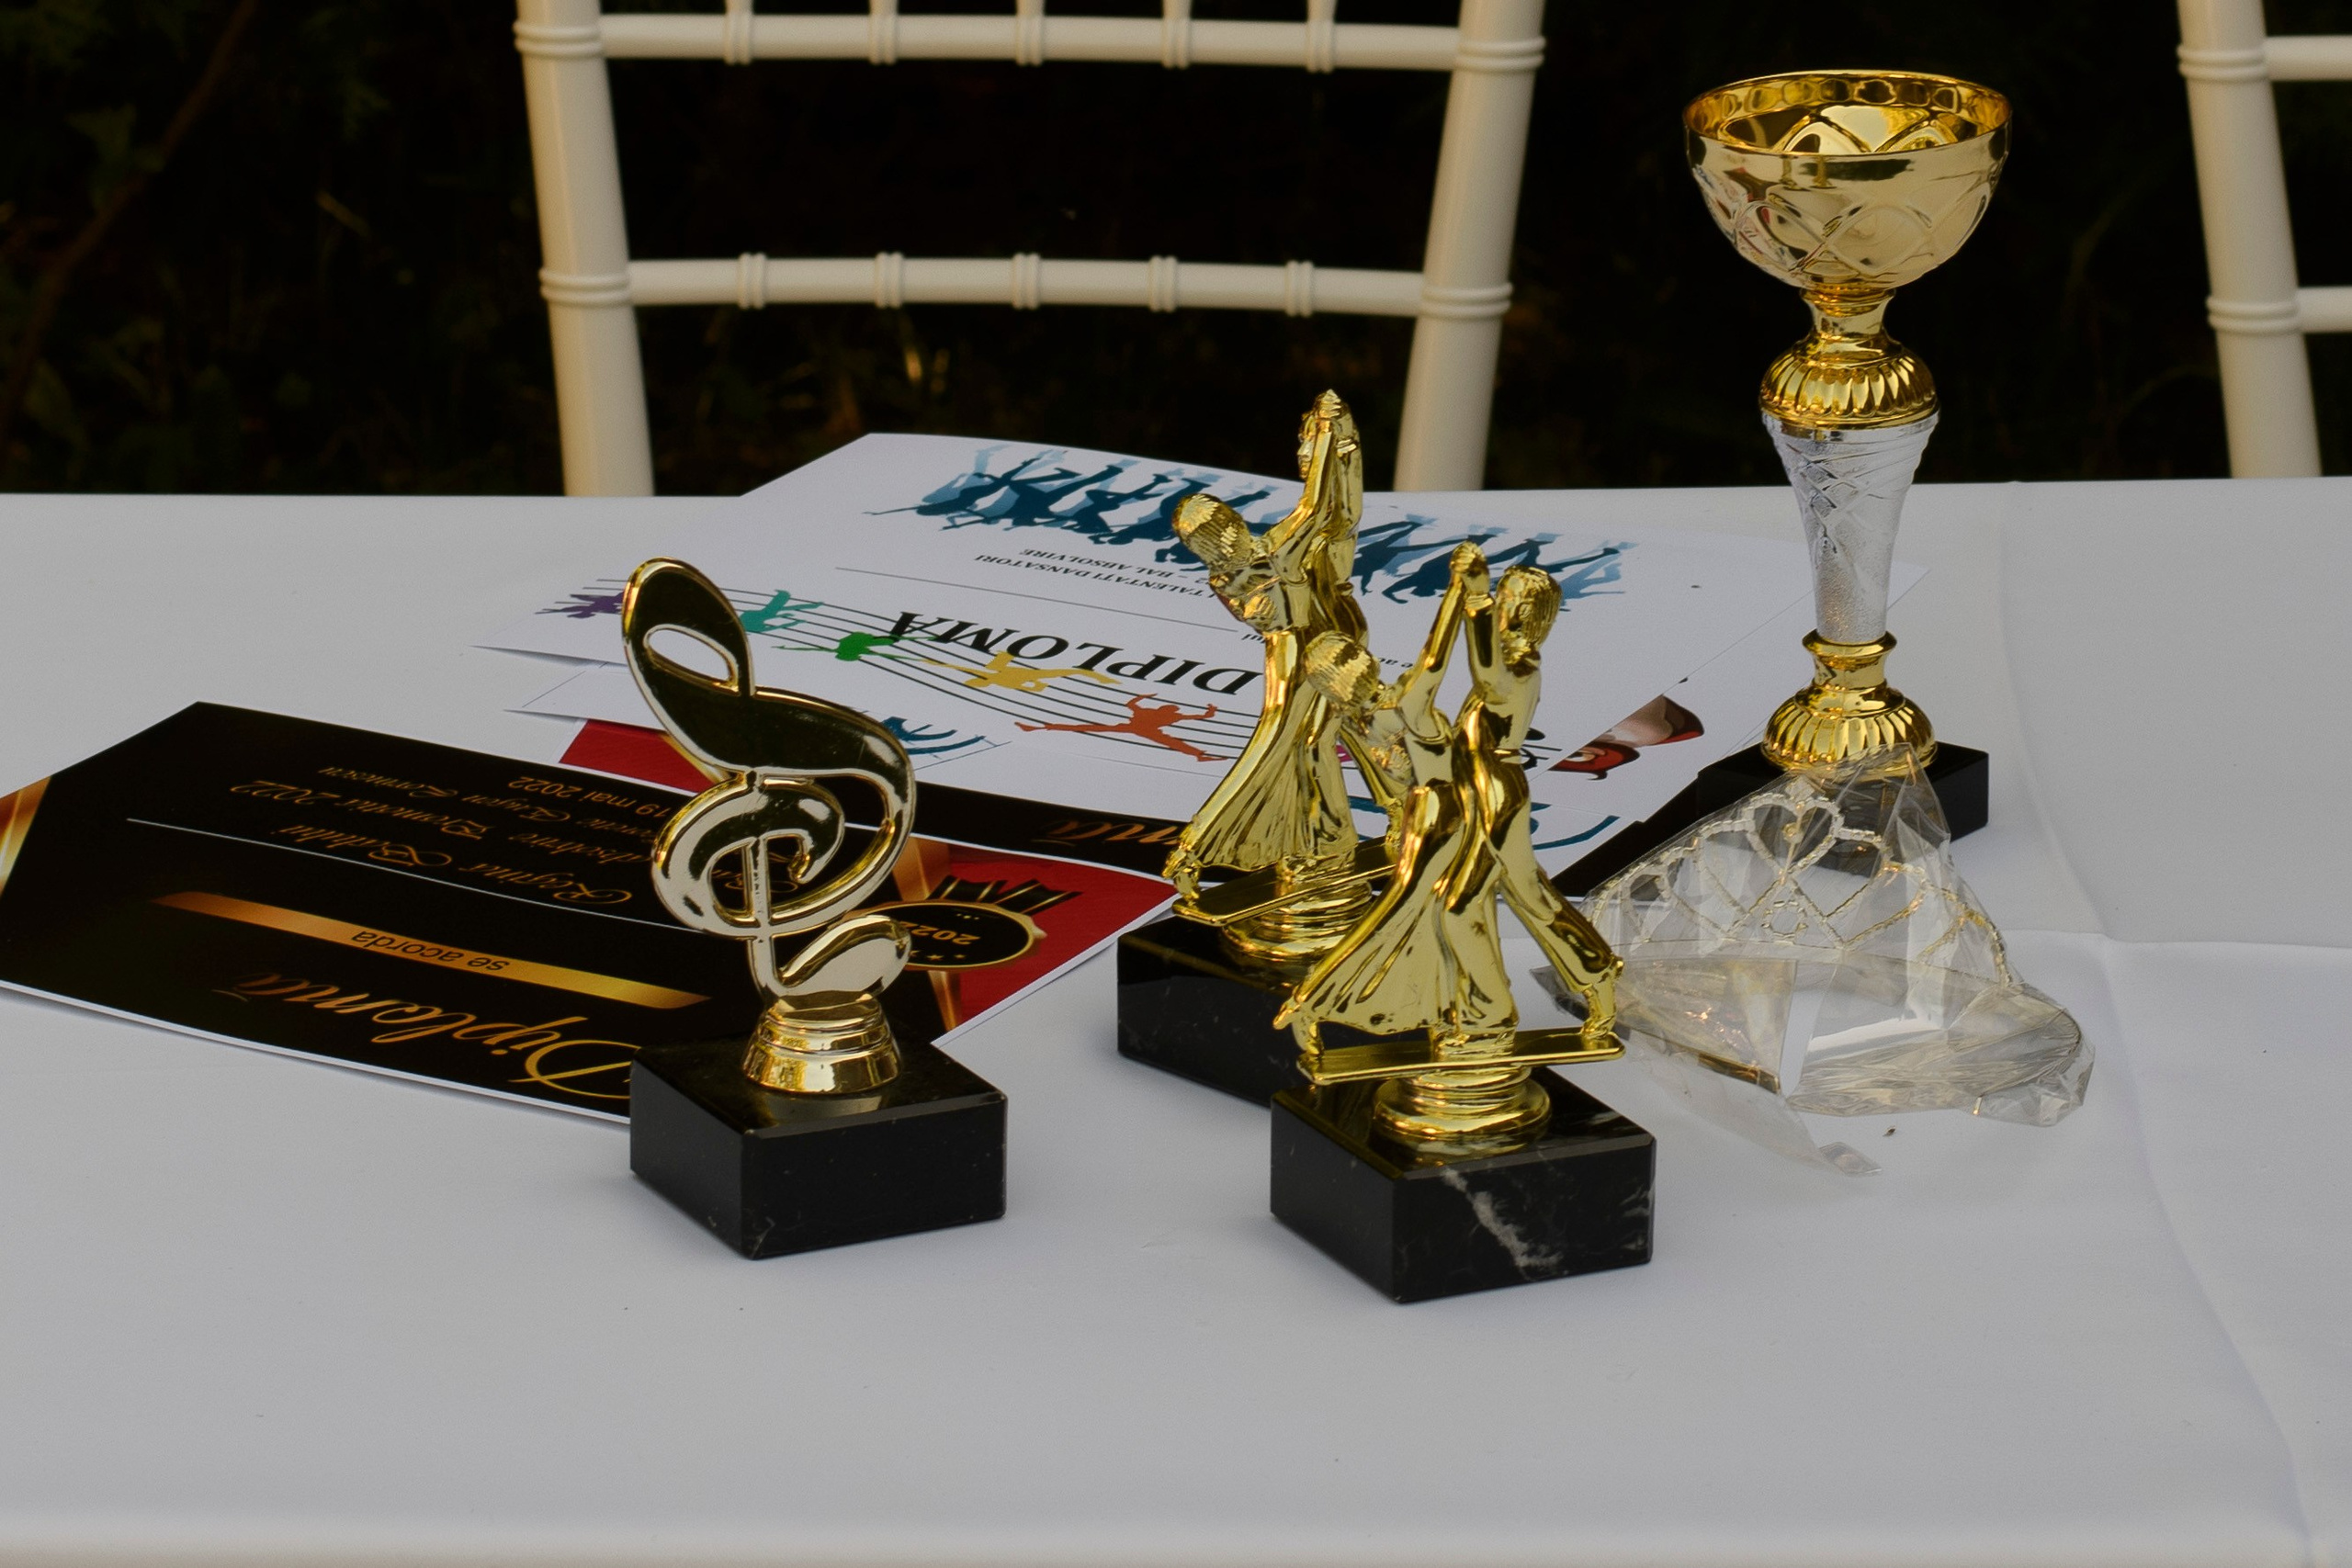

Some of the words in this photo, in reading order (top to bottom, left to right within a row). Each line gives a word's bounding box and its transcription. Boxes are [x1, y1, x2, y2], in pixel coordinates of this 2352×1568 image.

[974, 554, 1091, 578] DANSATORI
[1018, 548, 1133, 573] ABSOLVIRE
[1136, 566, 1174, 579] BAL
[889, 612, 1261, 695] DIPLOMA
[229, 780, 341, 806] 2022
[507, 775, 582, 799] 2022
[578, 791, 637, 811] mai
[635, 803, 672, 818] 19
[352, 931, 465, 962] acorda
[466, 953, 511, 972] se
